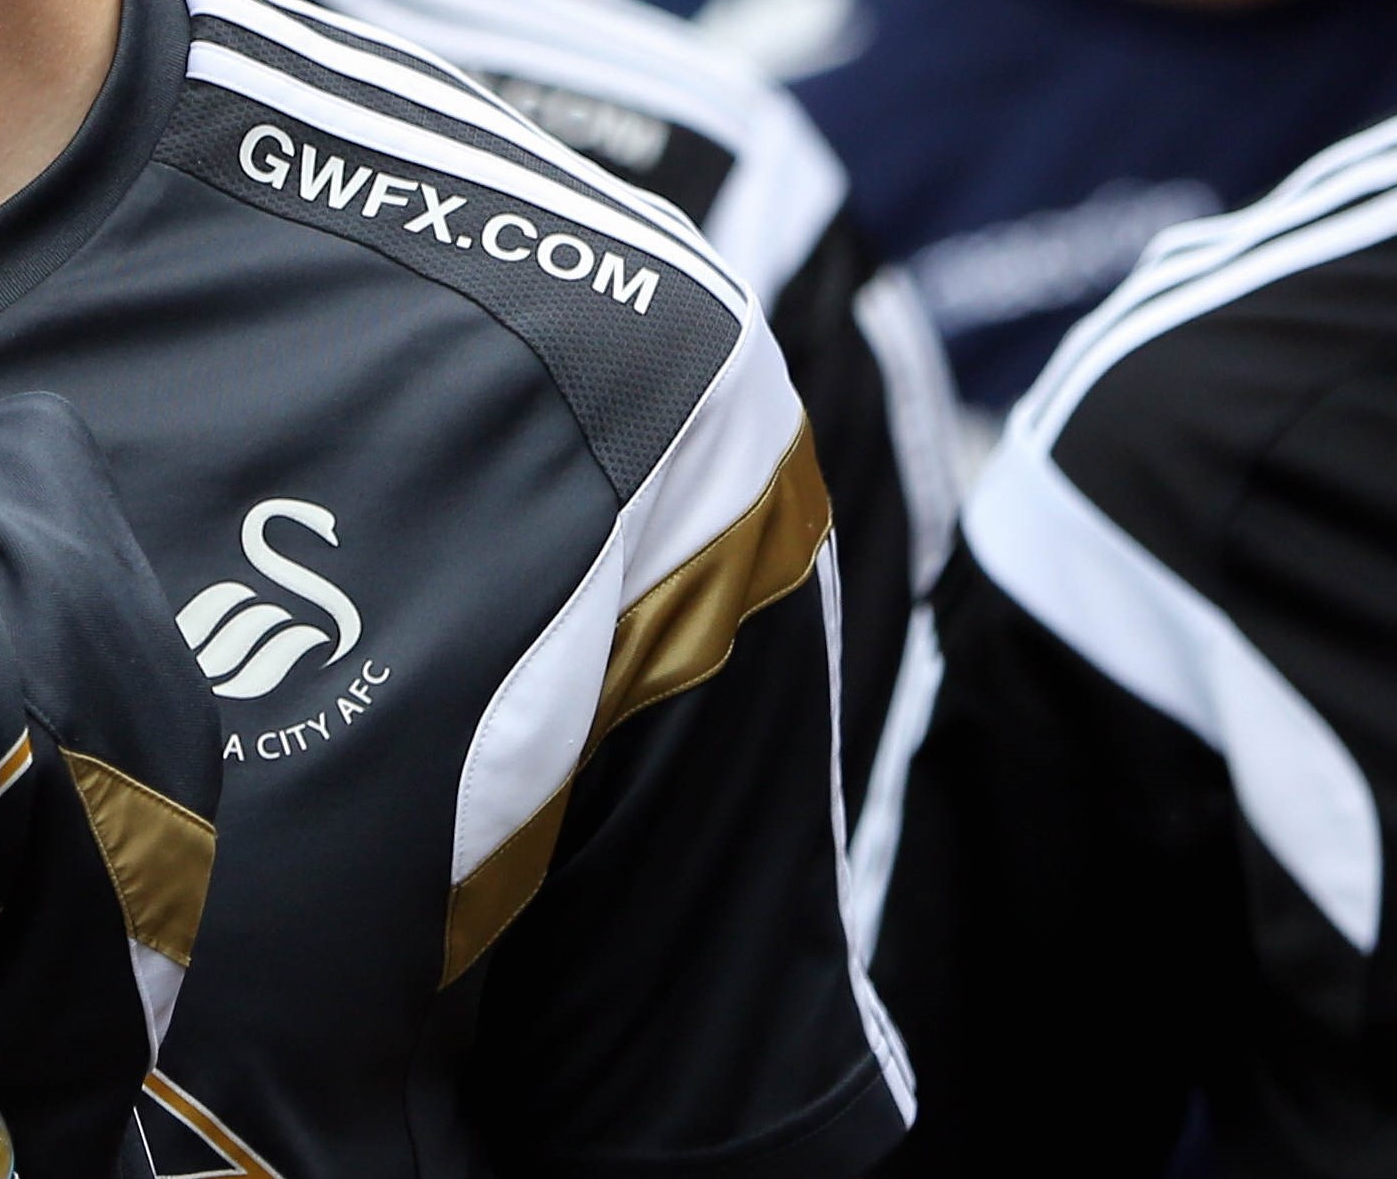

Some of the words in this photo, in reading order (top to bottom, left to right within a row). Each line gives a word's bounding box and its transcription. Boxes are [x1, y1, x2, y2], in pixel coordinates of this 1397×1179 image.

[238, 123, 661, 315] GWFX.COM
[222, 733, 245, 761] A
[256, 711, 331, 760] CITY
[336, 659, 391, 725] AFC
